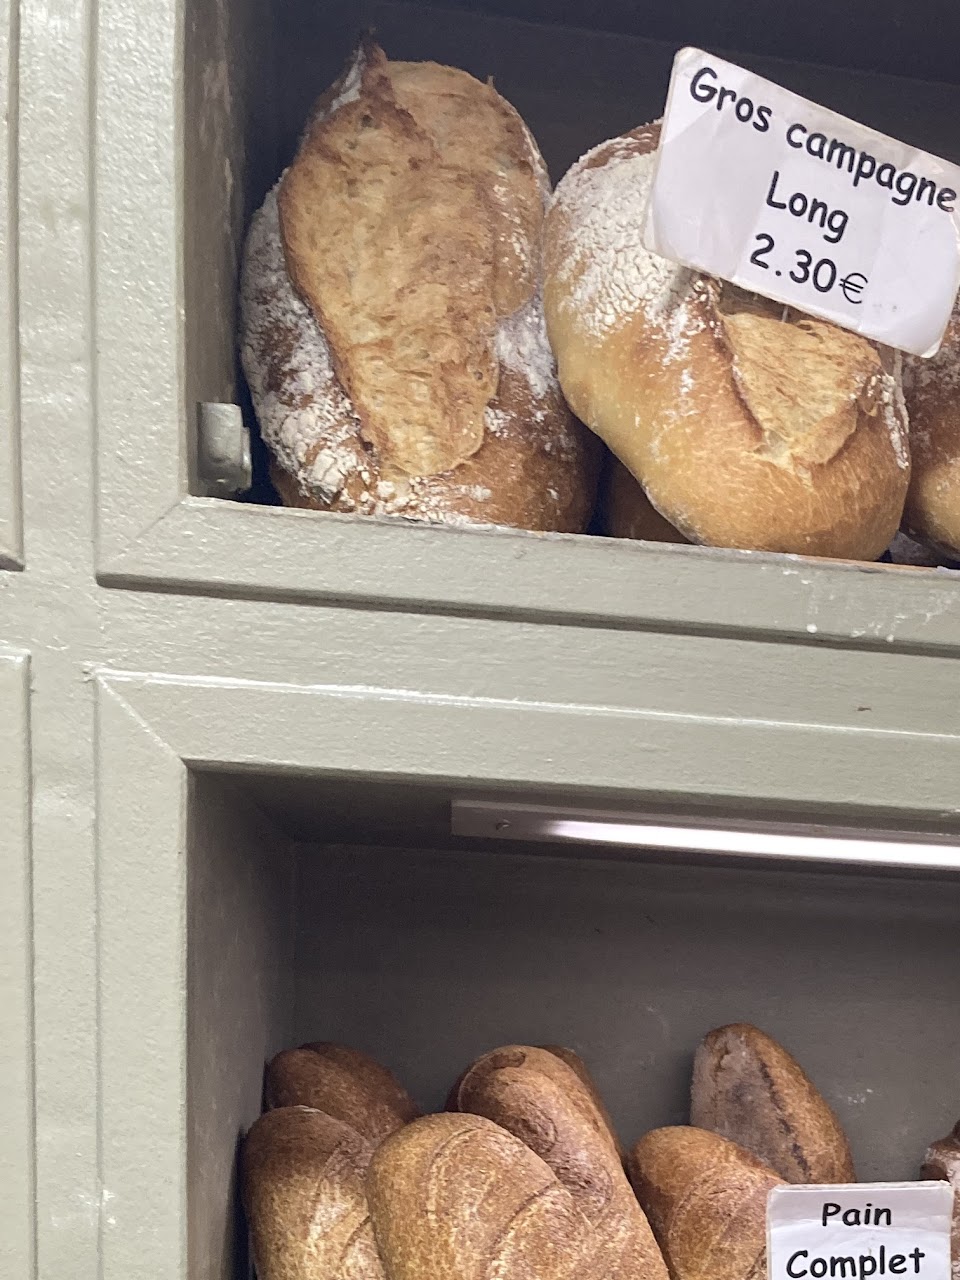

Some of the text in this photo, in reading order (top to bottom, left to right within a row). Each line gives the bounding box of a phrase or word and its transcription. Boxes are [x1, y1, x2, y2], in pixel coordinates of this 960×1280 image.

[689, 67, 957, 213] Gros campagne
[765, 170, 849, 244] Long
[750, 233, 868, 304] 2.30€
[822, 1202, 892, 1227] Pain
